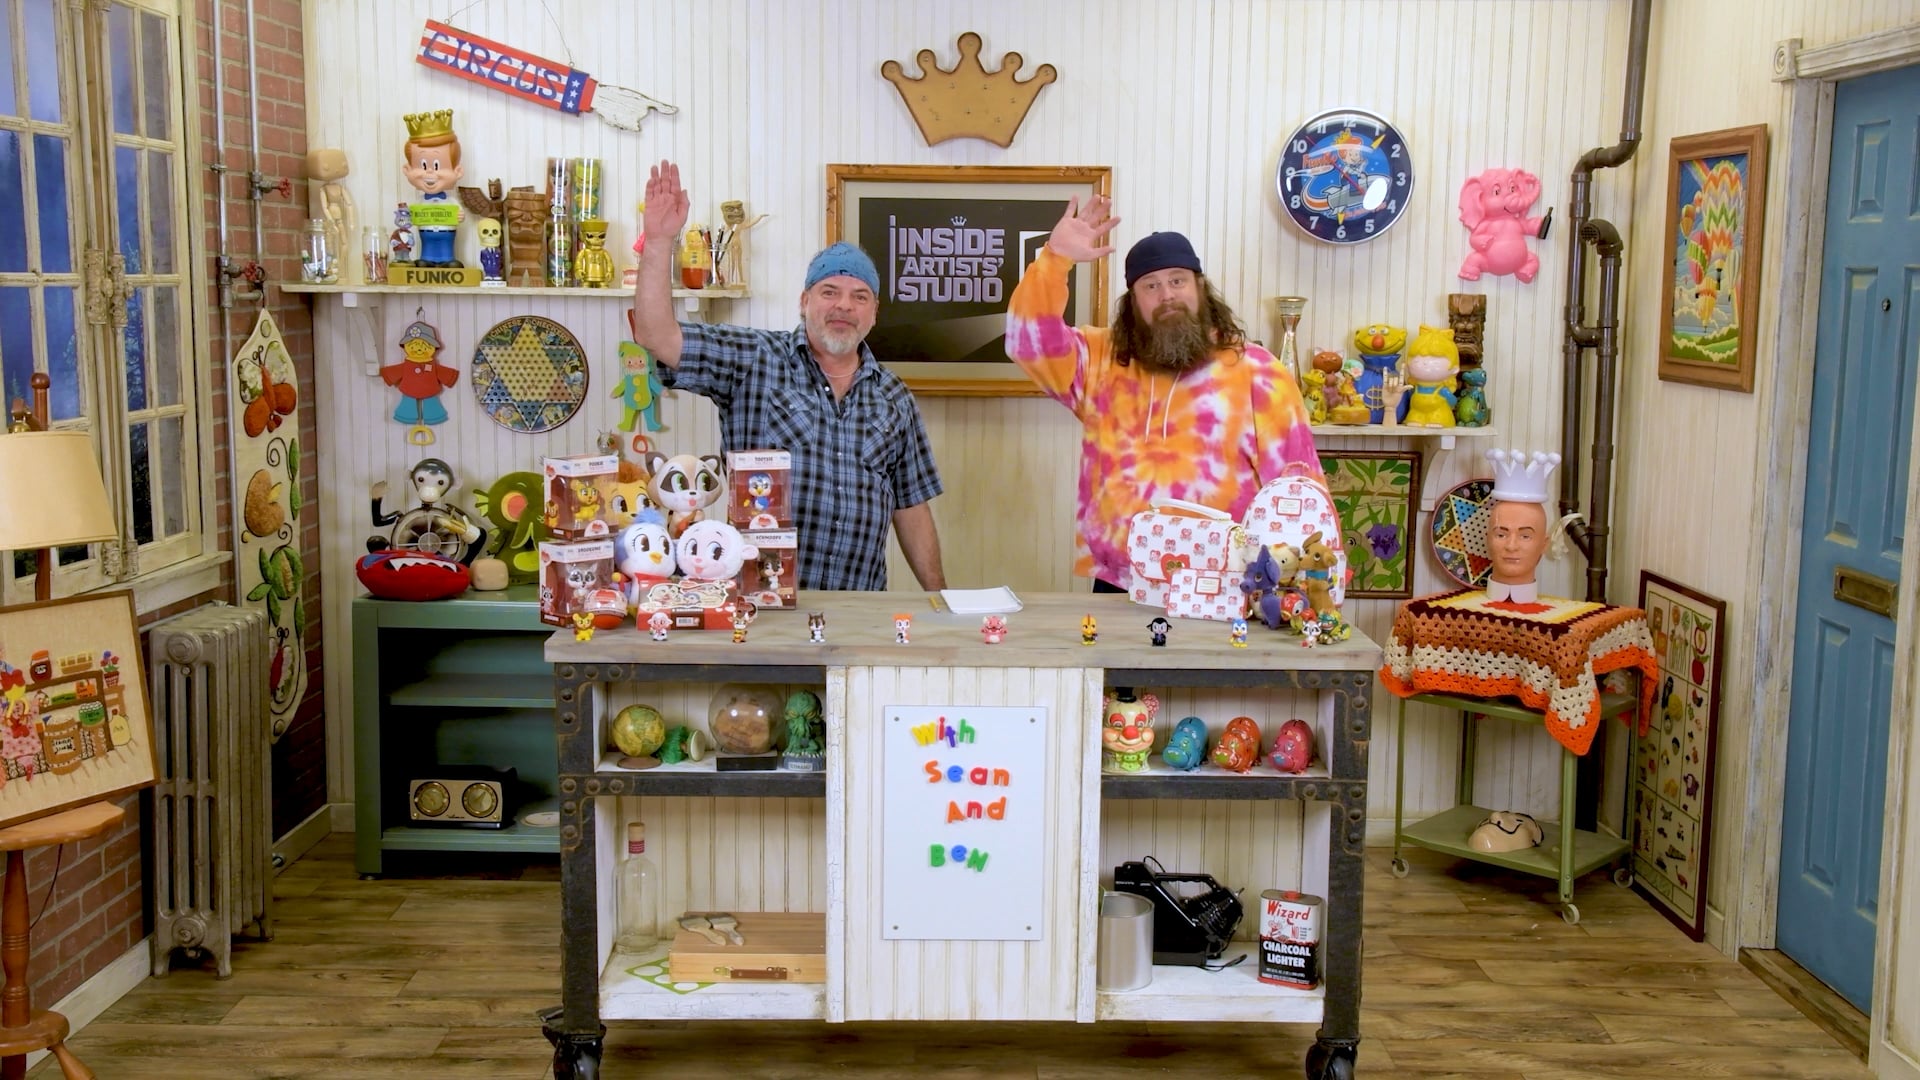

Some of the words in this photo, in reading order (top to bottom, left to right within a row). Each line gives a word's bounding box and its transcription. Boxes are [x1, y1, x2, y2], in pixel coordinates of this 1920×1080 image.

[423, 31, 562, 101] CIRCUS
[1292, 140, 1308, 153] 10
[1391, 144, 1401, 158] 2
[1396, 172, 1407, 187] 3
[1290, 195, 1301, 209] 8
[1387, 199, 1397, 213] 4
[1309, 216, 1320, 230] 7
[1364, 219, 1375, 233] 5
[1336, 225, 1347, 239] 6
[898, 228, 1005, 256] INSIDE
[406, 270, 465, 284] FUNKO
[897, 277, 1003, 303] STUDIO
[911, 716, 976, 747] With
[924, 760, 1010, 786] Sean
[946, 796, 1007, 823] And
[1267, 900, 1312, 921] Wizard
[1262, 940, 1311, 957] CHARCOAL
[1266, 953, 1306, 969] LIGHTER
